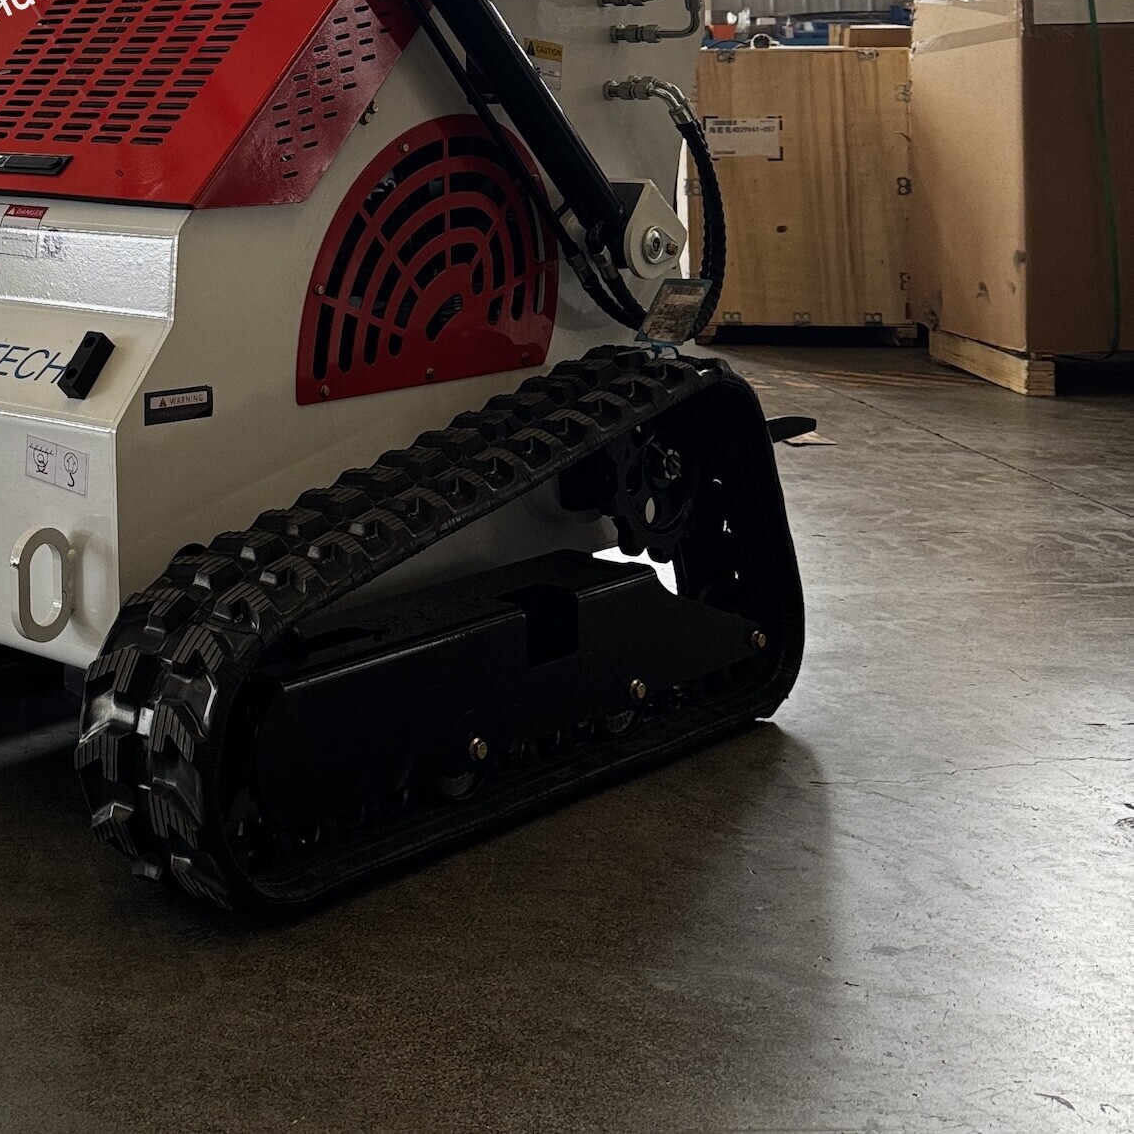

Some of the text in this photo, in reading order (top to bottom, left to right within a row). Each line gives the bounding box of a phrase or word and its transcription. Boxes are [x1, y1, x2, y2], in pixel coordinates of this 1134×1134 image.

[536, 45, 563, 57] CAUTION
[16, 209, 44, 217] DANGER
[169, 393, 204, 406] WARNING
